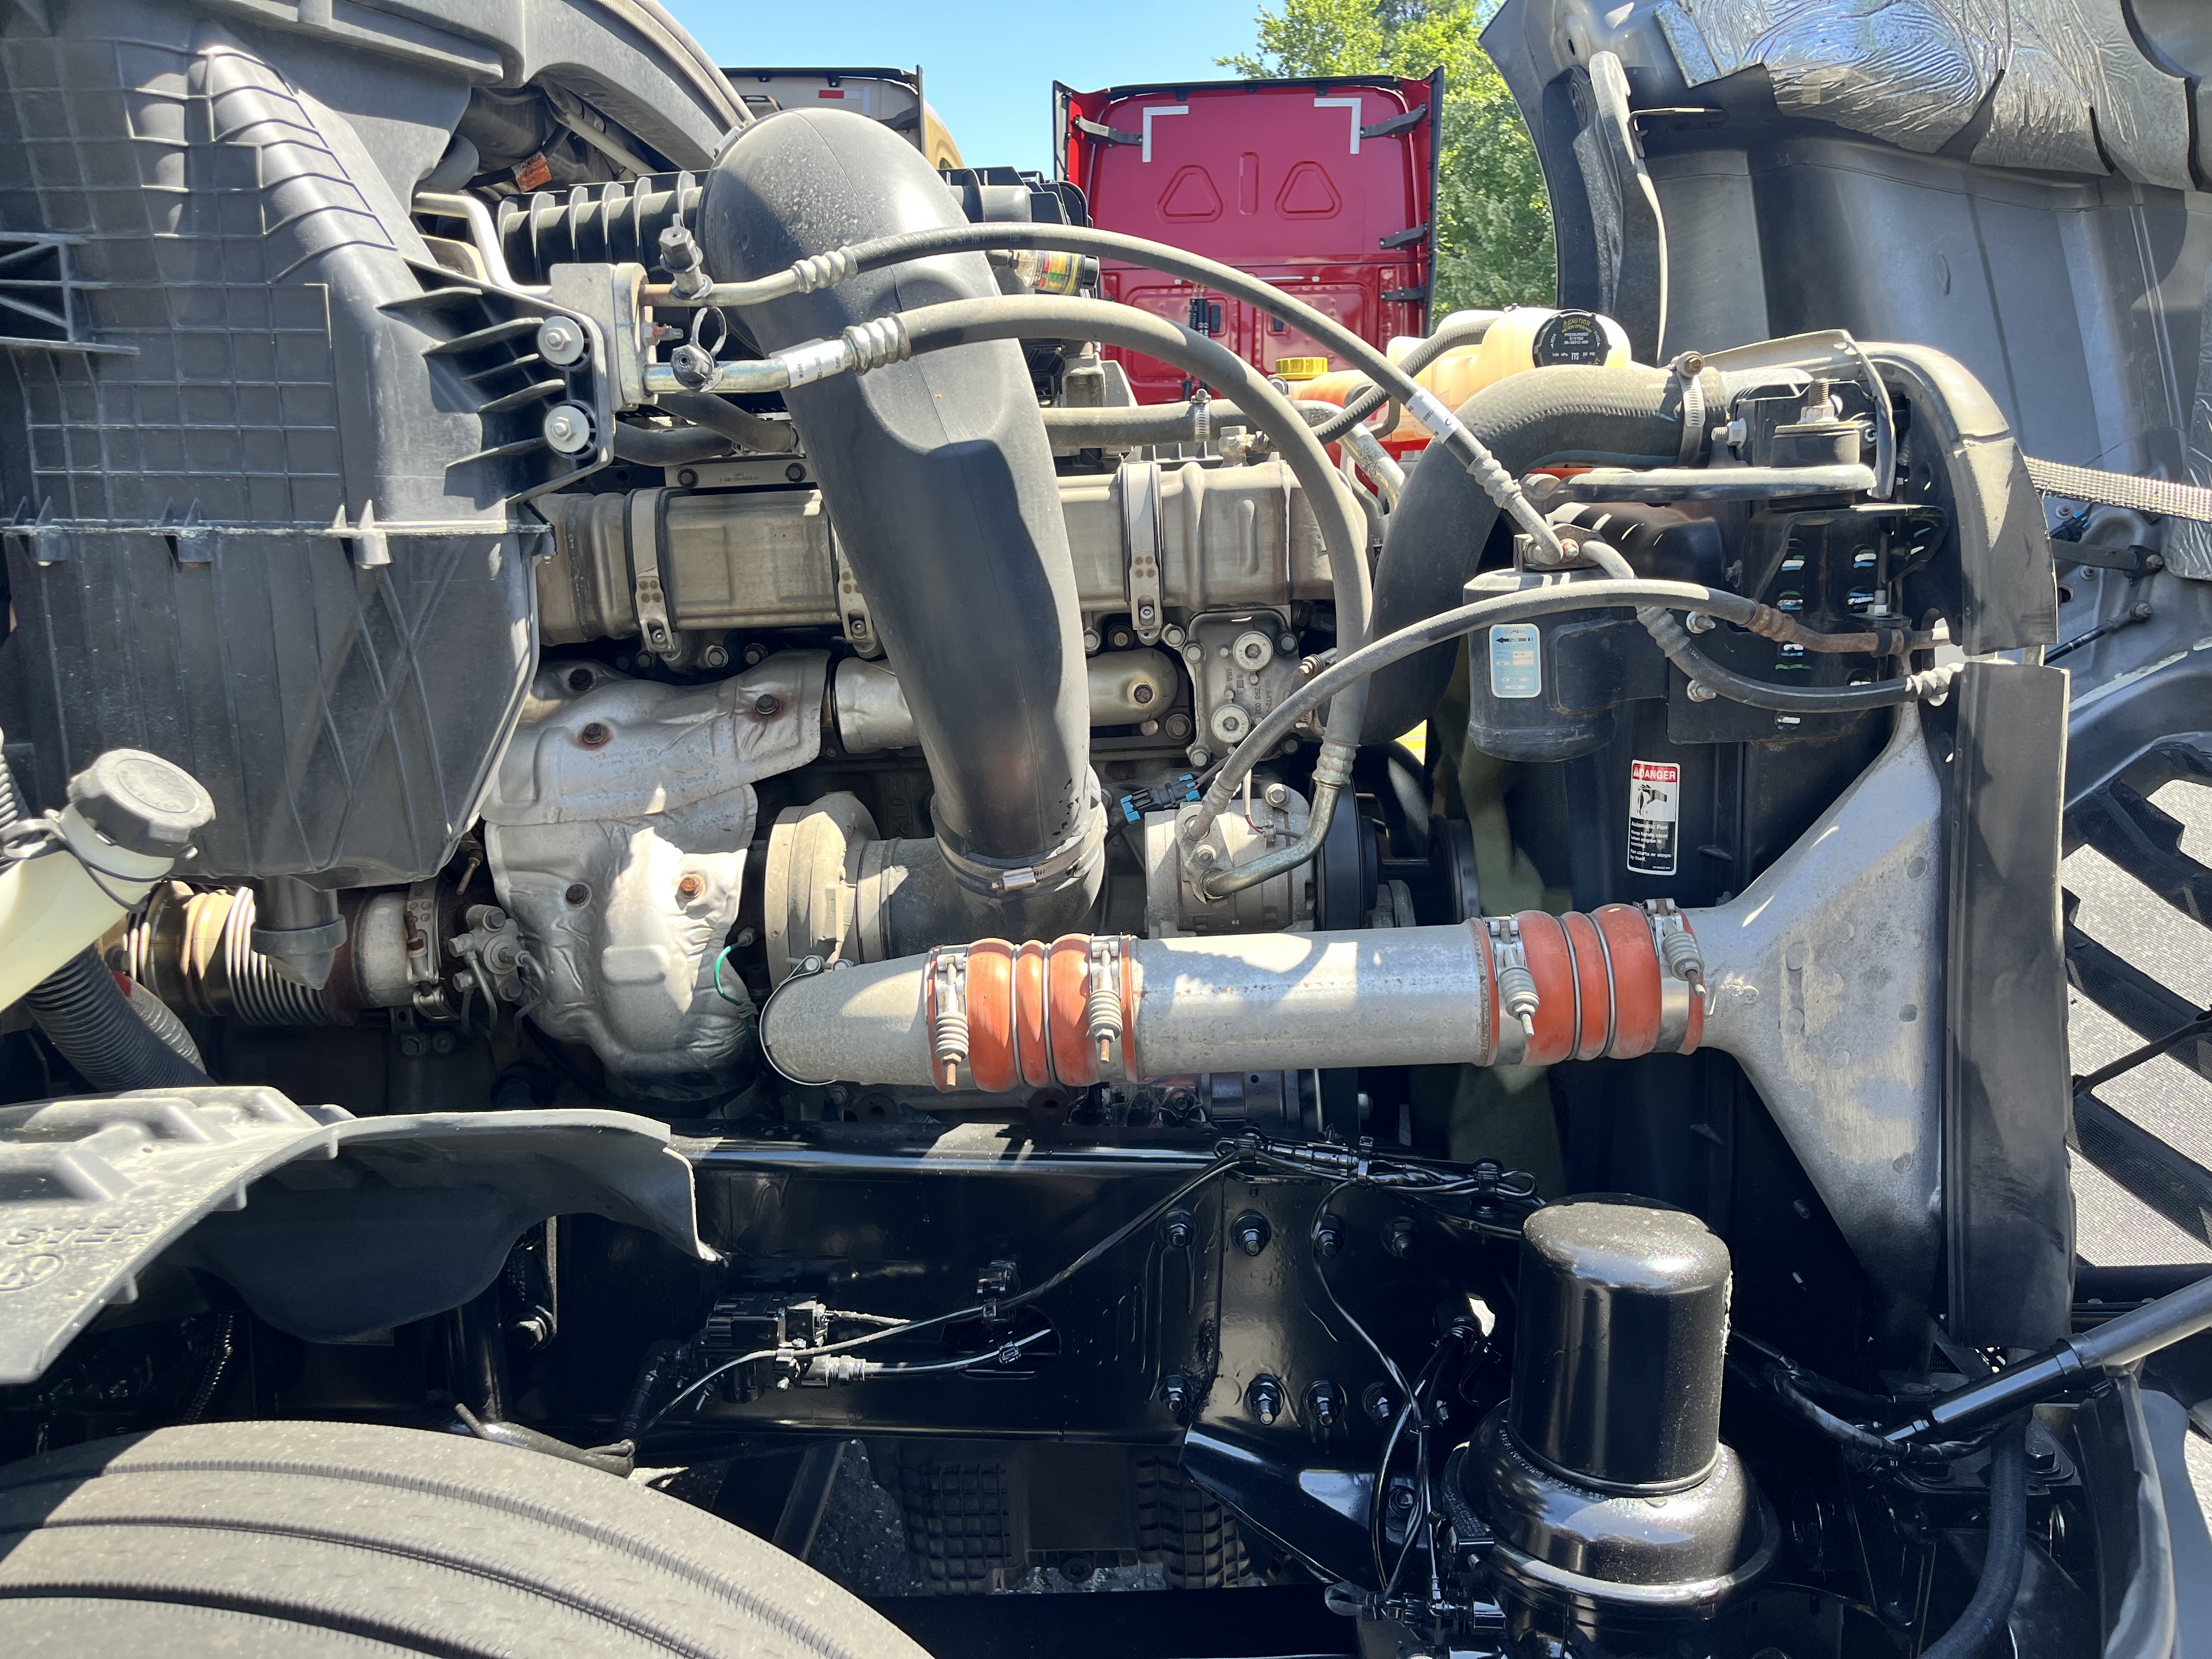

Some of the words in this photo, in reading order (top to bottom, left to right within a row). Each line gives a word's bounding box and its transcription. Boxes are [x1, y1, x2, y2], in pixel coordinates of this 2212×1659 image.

[1568, 318, 1590, 326] CAUTION
[1639, 768, 1675, 780] DANGER
[1631, 821, 1656, 830] Automatic
